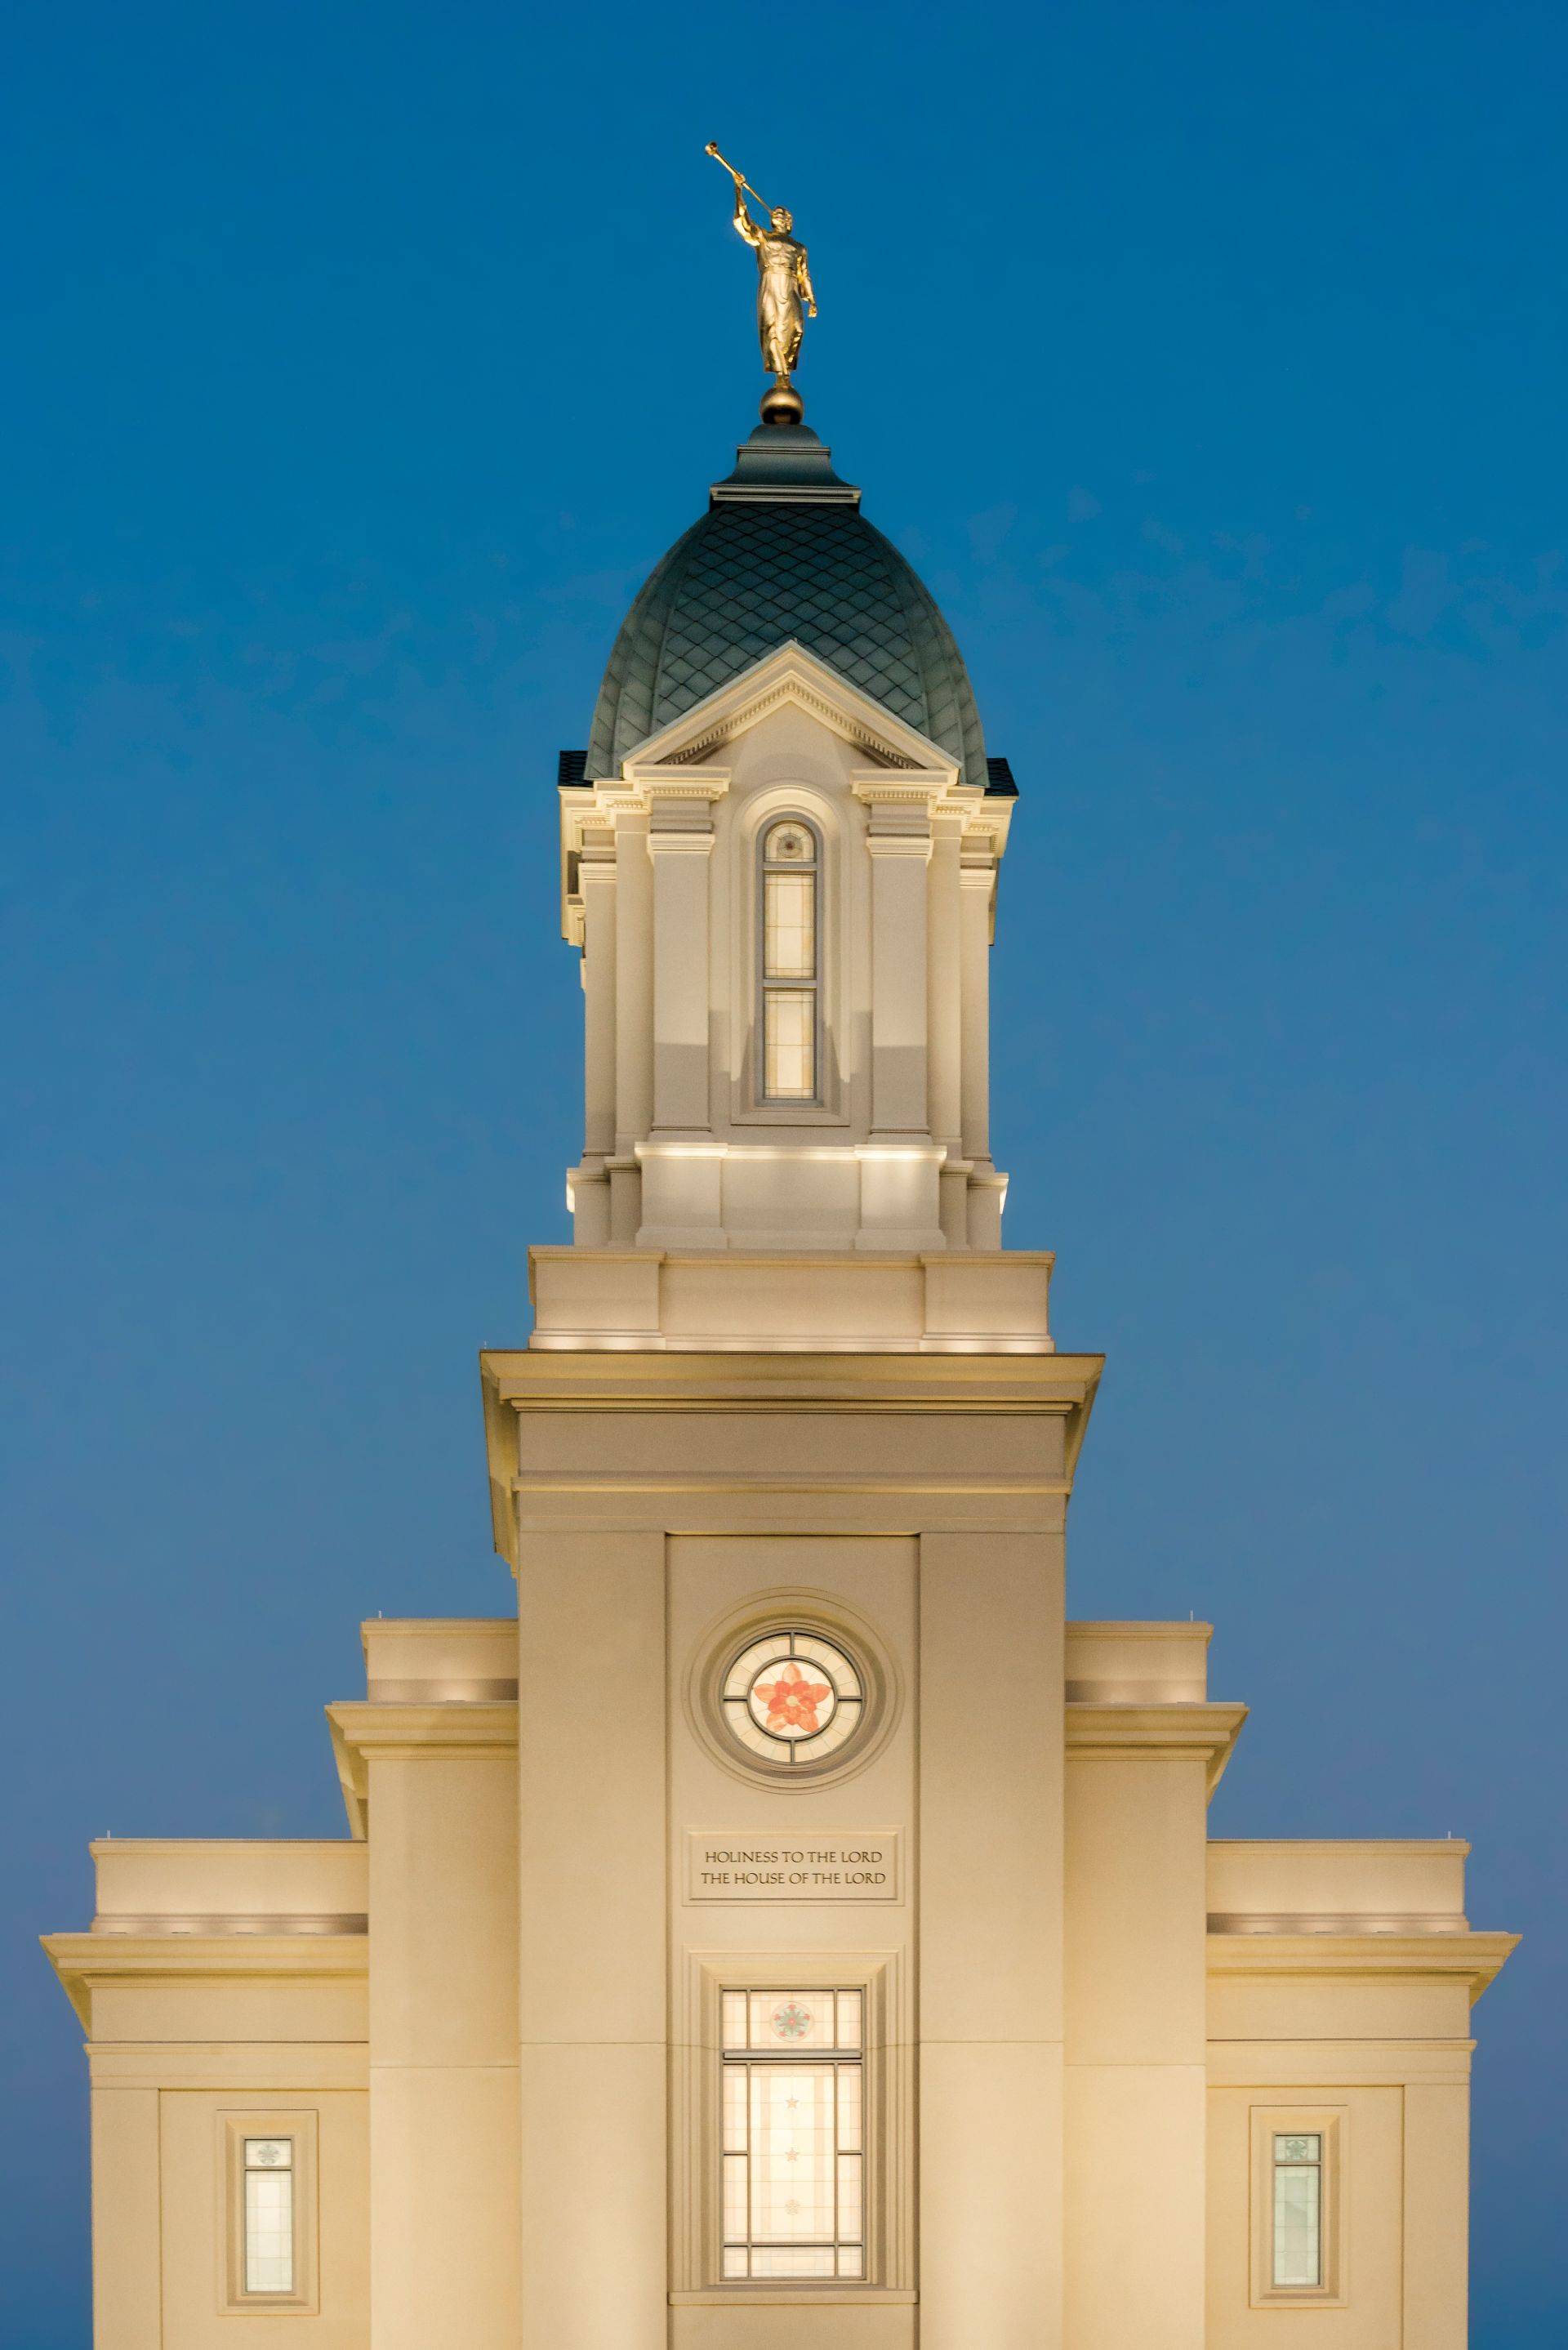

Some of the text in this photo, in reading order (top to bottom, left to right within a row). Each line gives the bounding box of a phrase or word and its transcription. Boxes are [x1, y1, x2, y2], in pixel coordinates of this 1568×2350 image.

[705, 1851, 883, 1863] HOLINESS TO THE LORD
[701, 1872, 886, 1884] THE HOUSE OF THE LORD
